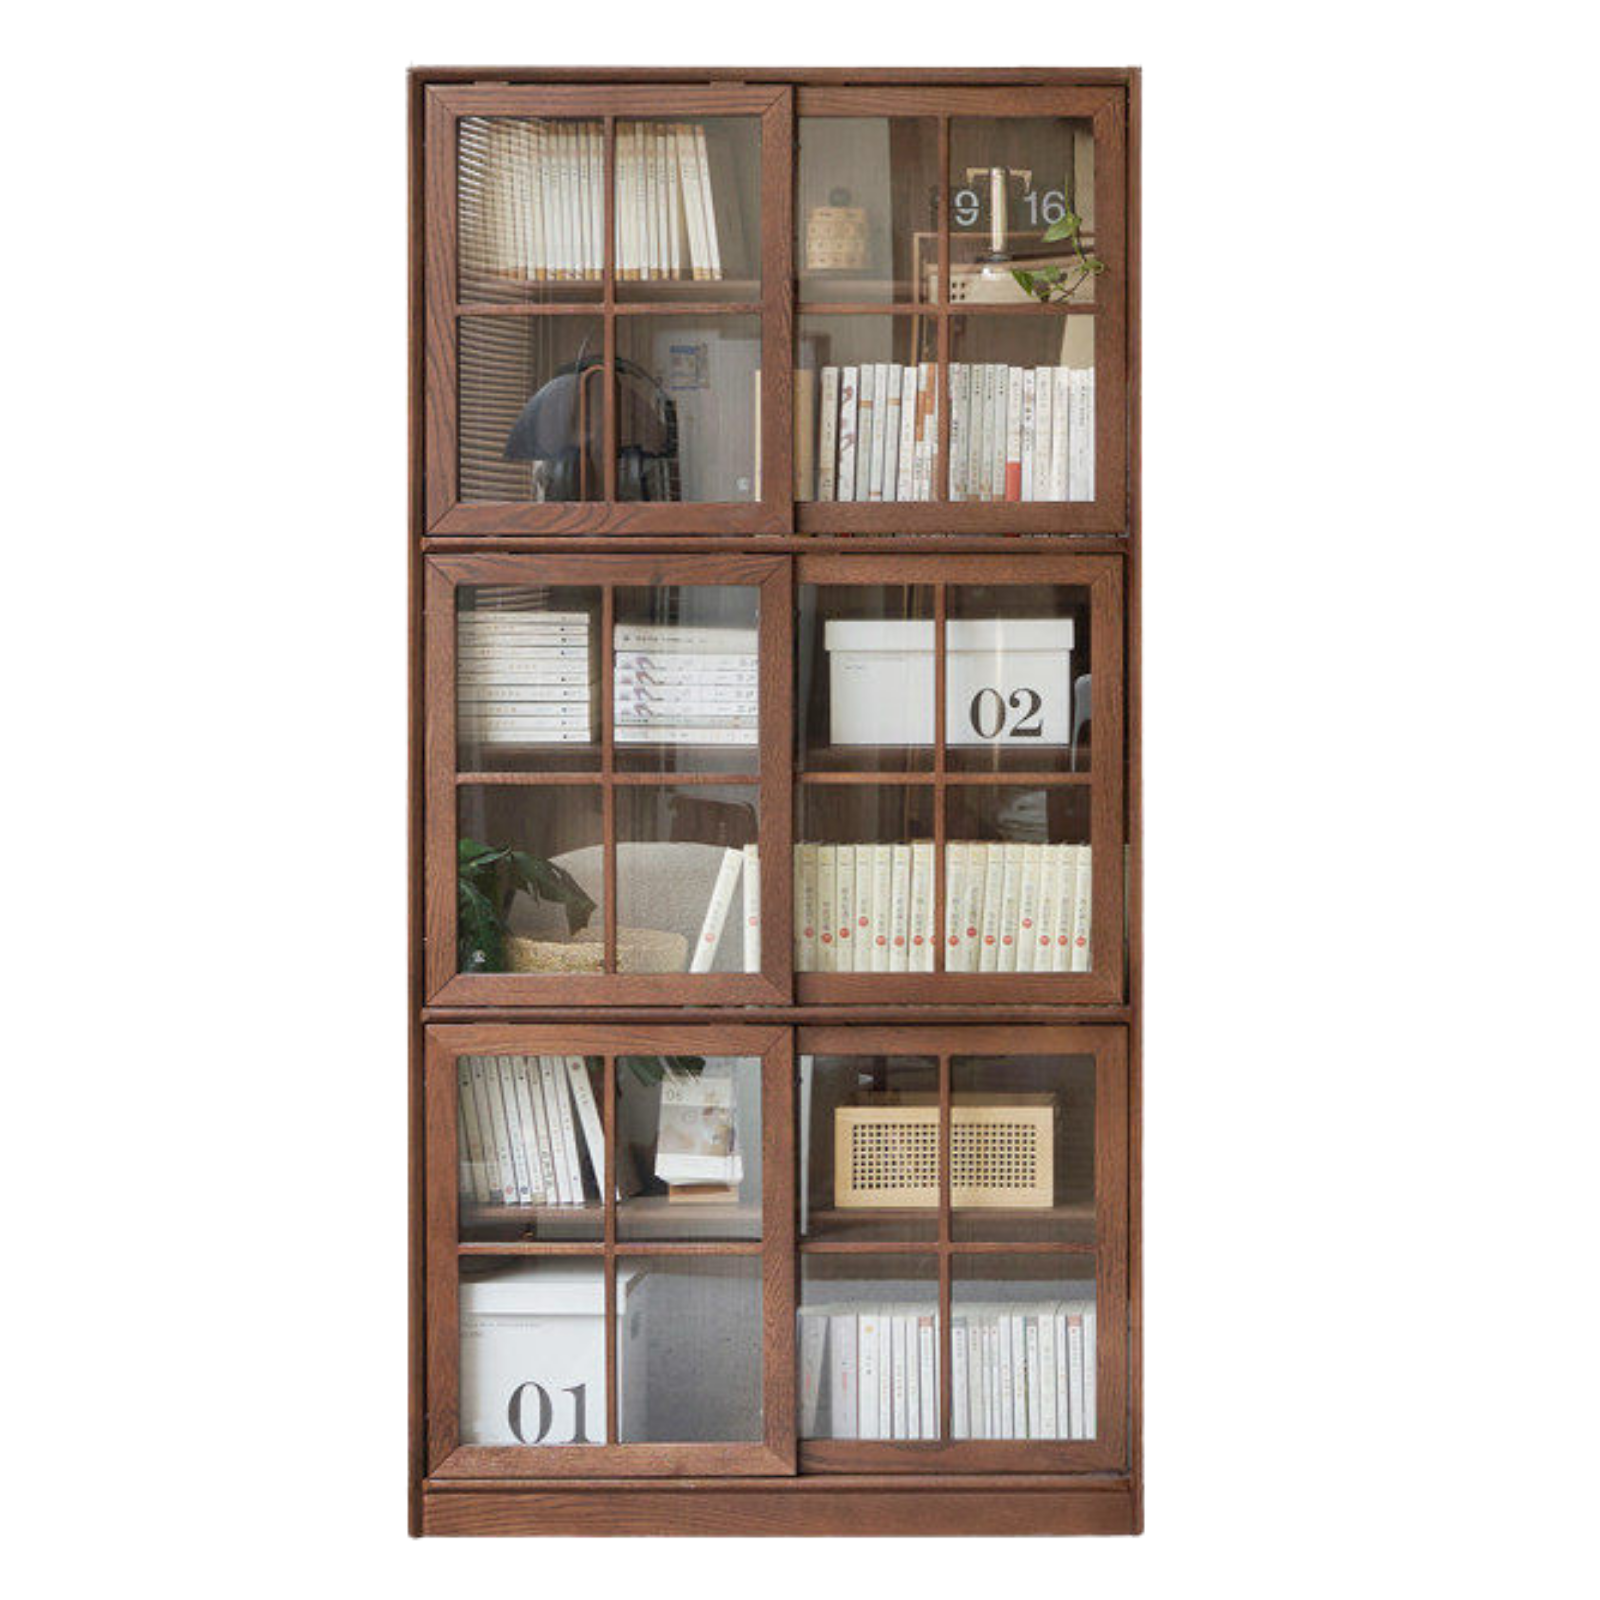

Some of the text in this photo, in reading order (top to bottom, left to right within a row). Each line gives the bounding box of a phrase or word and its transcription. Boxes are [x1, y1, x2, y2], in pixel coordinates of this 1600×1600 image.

[937, 190, 1066, 226] 9 16
[970, 688, 1044, 739] 02
[508, 1381, 601, 1444] 01
